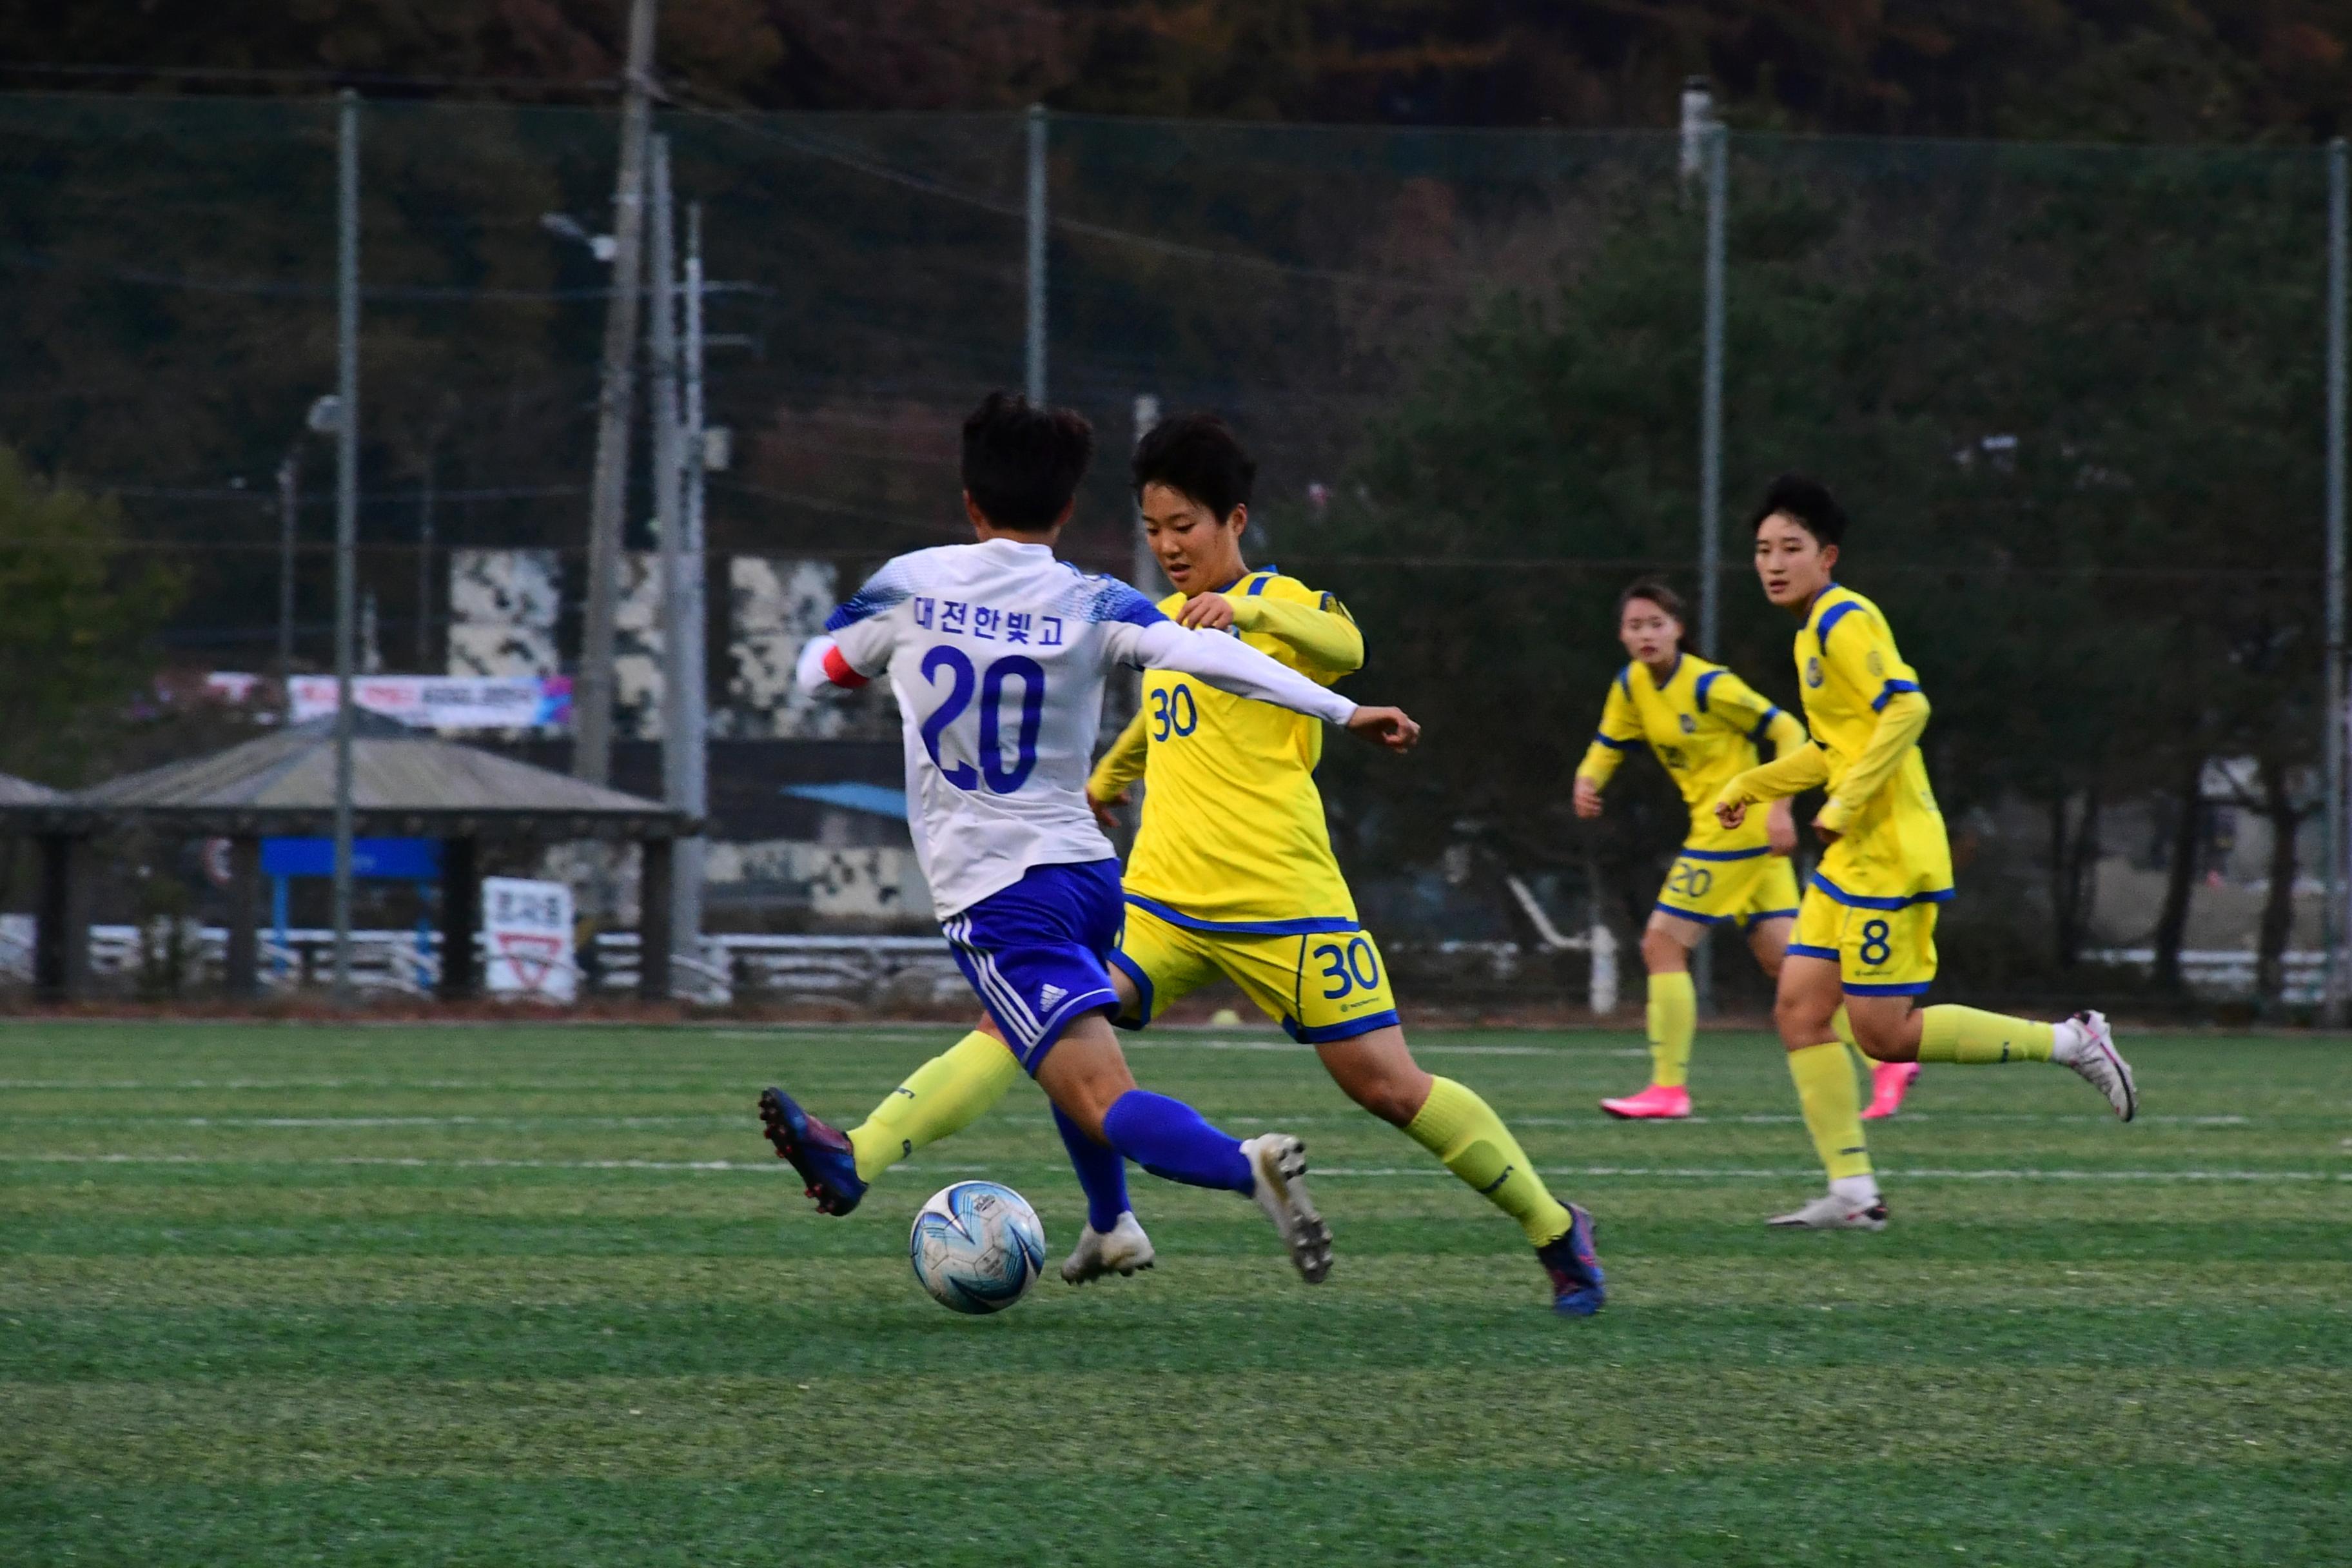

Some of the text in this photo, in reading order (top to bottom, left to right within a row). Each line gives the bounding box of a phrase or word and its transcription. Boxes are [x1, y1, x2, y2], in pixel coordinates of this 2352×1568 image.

[915, 597, 1062, 645] 대전한빛고
[921, 645, 1044, 794] 20
[1151, 684, 1197, 742] 30
[1669, 863, 1712, 897] 20
[1313, 937, 1378, 999] 30
[1860, 920, 1890, 965] 8
